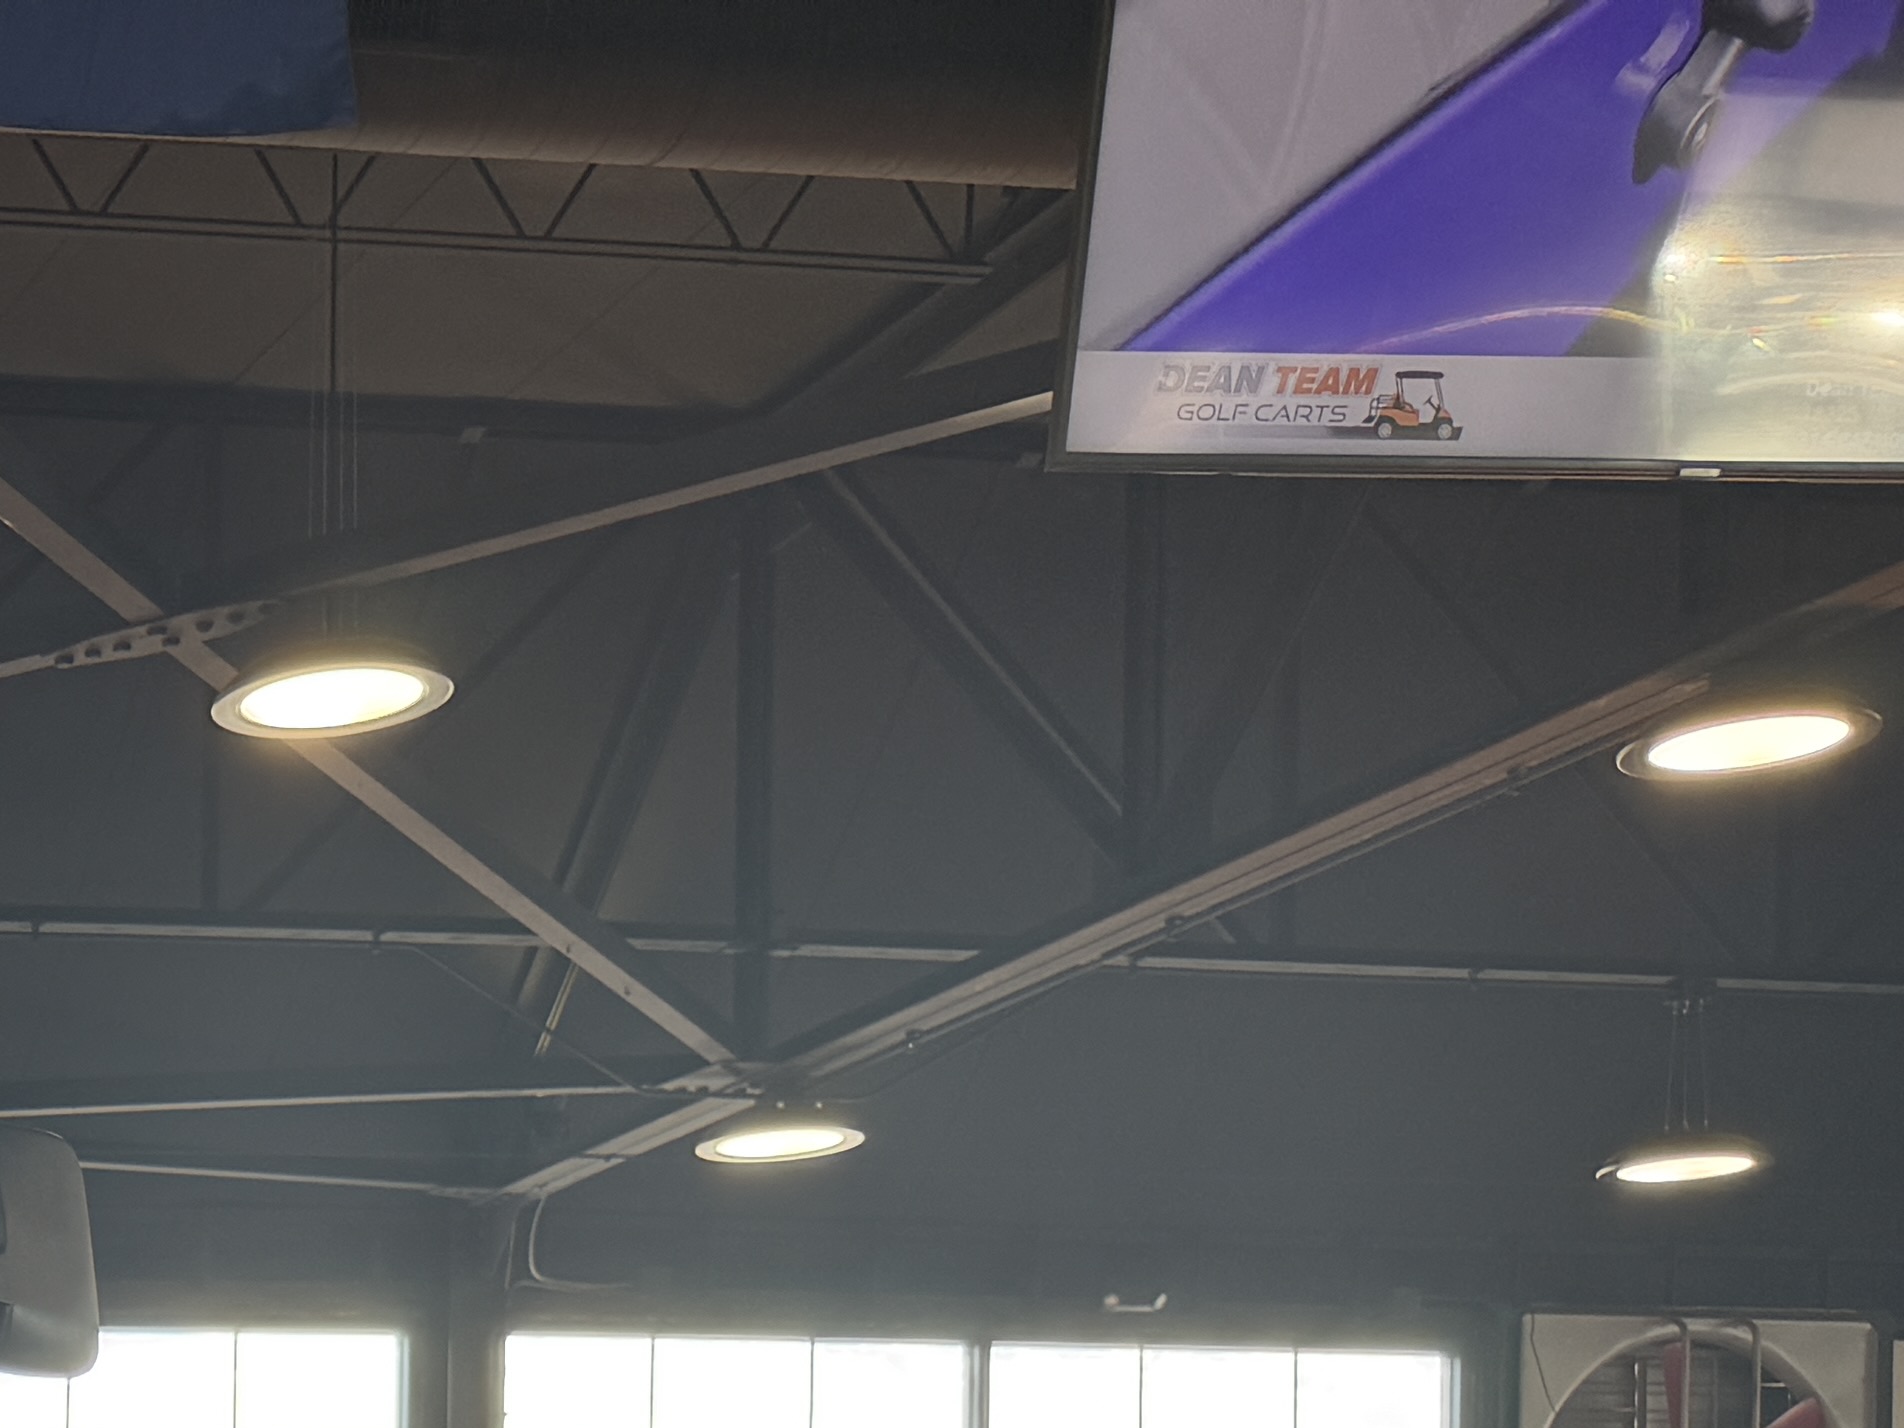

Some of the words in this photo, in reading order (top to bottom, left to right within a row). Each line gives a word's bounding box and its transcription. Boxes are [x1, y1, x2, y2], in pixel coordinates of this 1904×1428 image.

[1156, 364, 1266, 394] DEAN
[1275, 366, 1380, 396] TEAM
[1176, 403, 1249, 422] GOLF
[1254, 404, 1349, 423] CARTS
